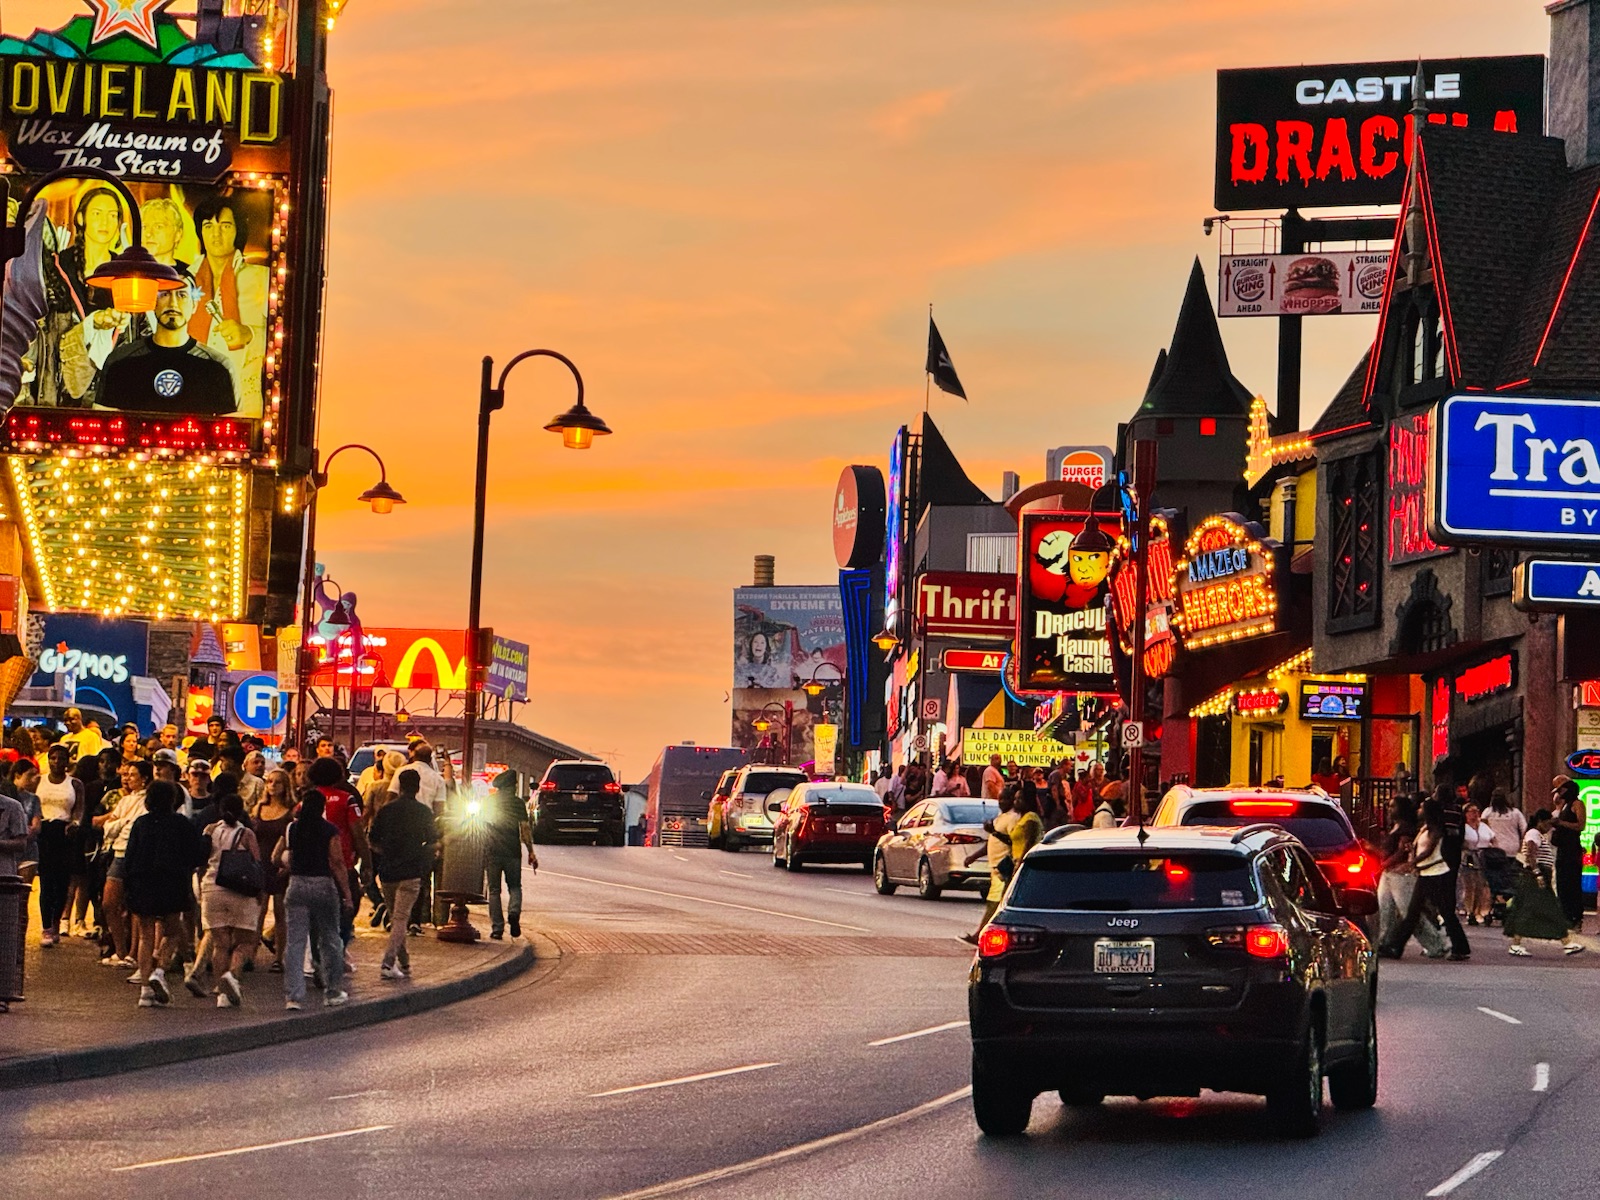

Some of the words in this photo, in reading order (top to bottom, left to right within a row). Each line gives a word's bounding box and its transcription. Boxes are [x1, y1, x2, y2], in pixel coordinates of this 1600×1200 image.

[9, 61, 283, 143] OVIELAND
[17, 119, 75, 145] Wax
[75, 121, 187, 151] Museum
[192, 129, 223, 163] of
[54, 148, 102, 168] The
[107, 151, 182, 176] Stars
[1232, 258, 1269, 268] STRAIGHT
[1236, 273, 1264, 287] BURGER
[1237, 279, 1265, 294] KING
[1236, 304, 1262, 313] AHEAD
[1283, 298, 1339, 309] WHOPPER
[1062, 466, 1103, 476] BURGER
[1561, 507, 1598, 526] BY
[1233, 549, 1247, 570] OF
[770, 600, 826, 610] EXTREME
[1183, 576, 1267, 631] MIRRORS
[981, 654, 999, 668] At
[1063, 654, 1114, 674] Castle
[1237, 694, 1277, 708] TICKETS
[971, 732, 987, 741] ALL
[993, 733, 1012, 741] DAY
[975, 742, 999, 751] OPEN
[1006, 744, 1034, 752] DAILY
[1042, 744, 1048, 753] 8
[1050, 745, 1064, 753] AM
[1019, 755, 1050, 764] DINNER
[1107, 917, 1139, 929] Jeep
